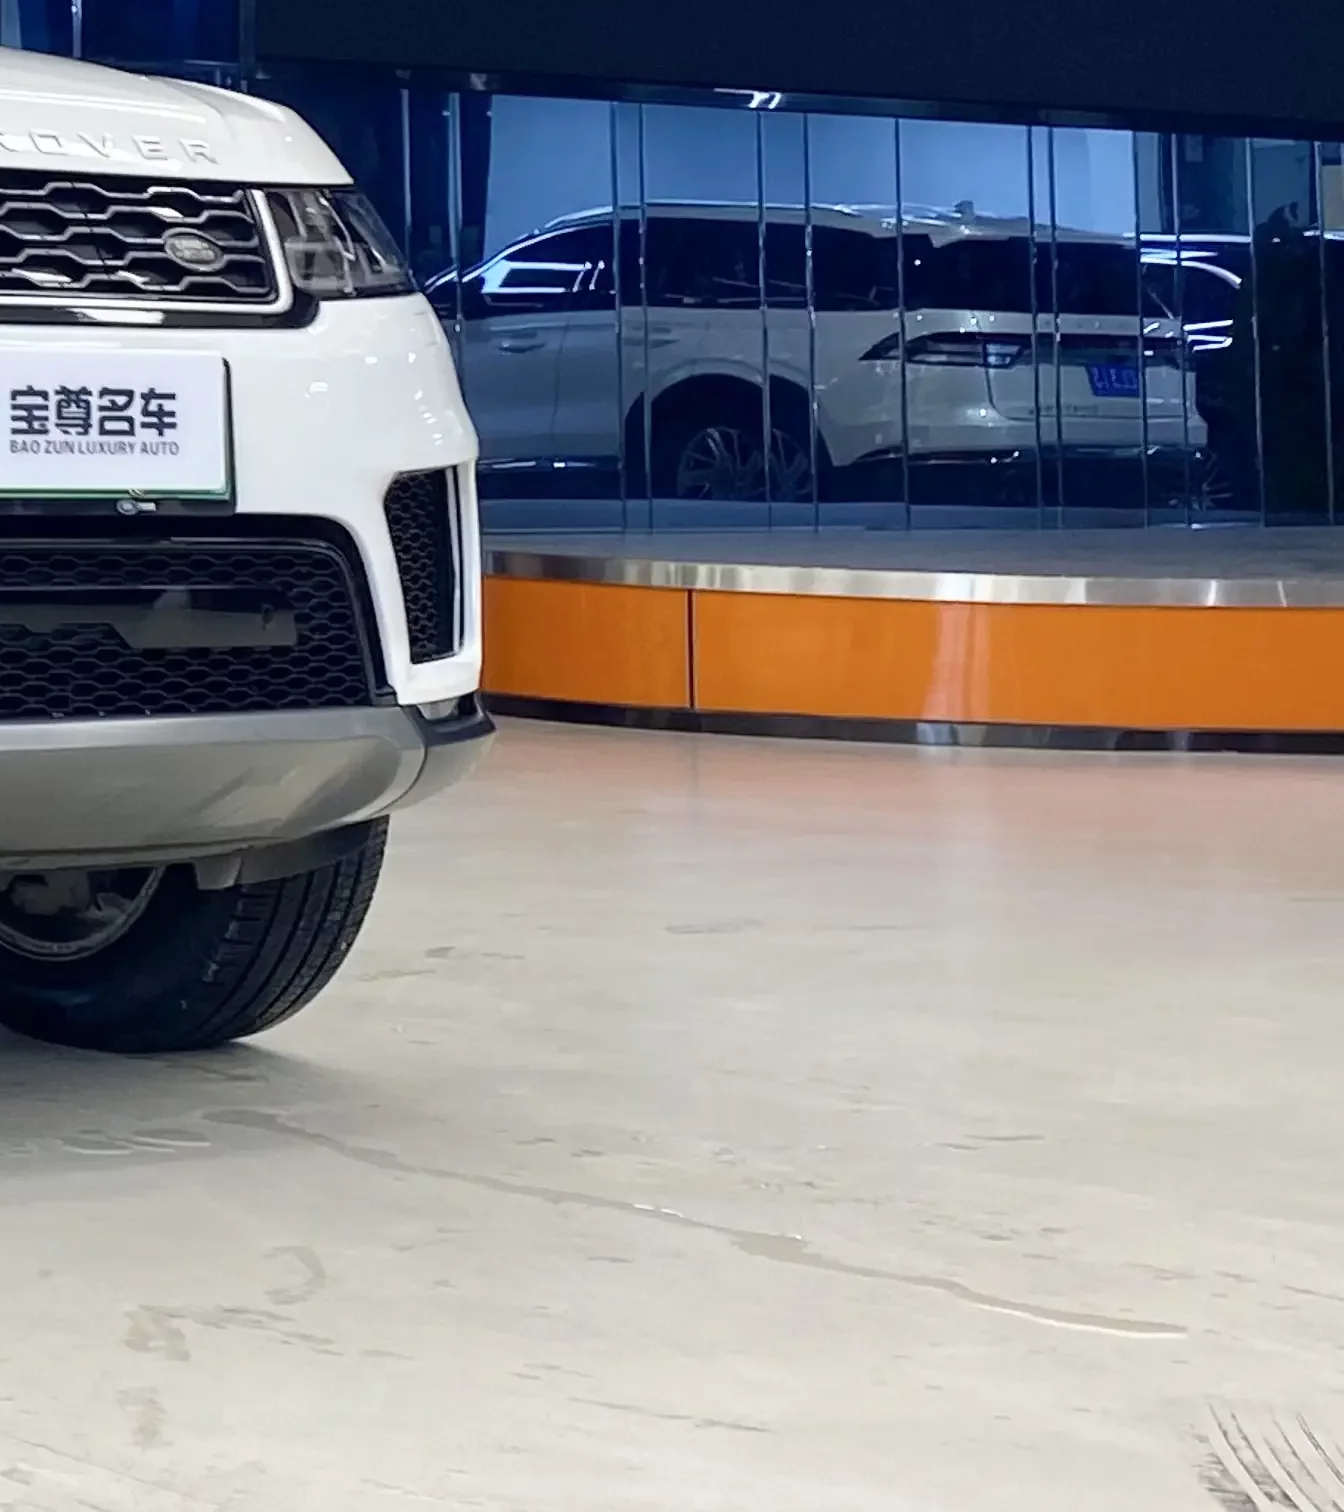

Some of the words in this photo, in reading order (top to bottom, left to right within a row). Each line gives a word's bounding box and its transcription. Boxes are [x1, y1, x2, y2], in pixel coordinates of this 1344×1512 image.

[10, 385, 178, 437] 宝尊名车
[10, 439, 41, 455] BAO
[44, 439, 75, 455] ZUN
[78, 439, 137, 456] LUXURY
[140, 440, 180, 456] AUTO
